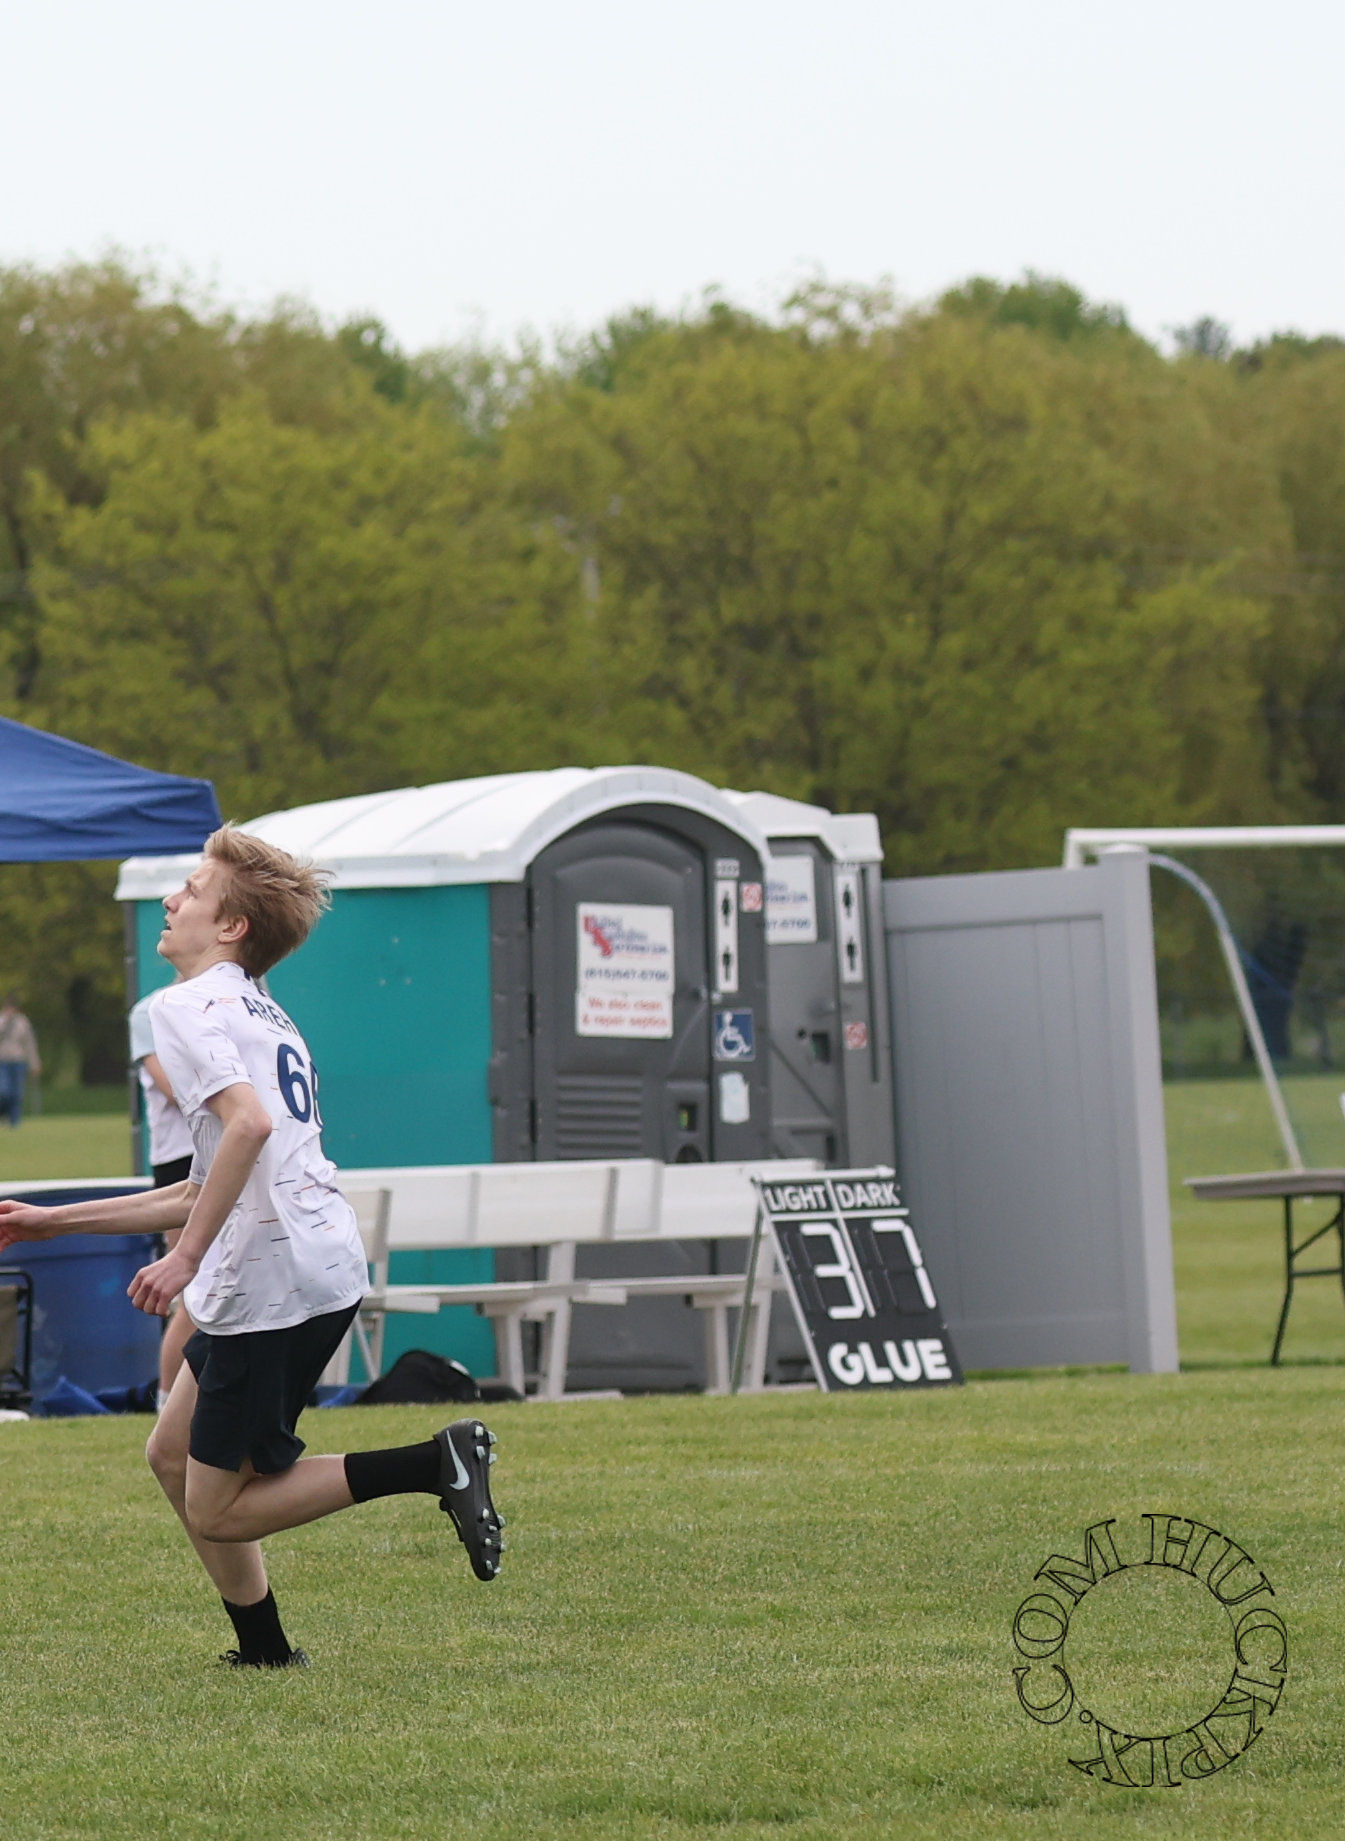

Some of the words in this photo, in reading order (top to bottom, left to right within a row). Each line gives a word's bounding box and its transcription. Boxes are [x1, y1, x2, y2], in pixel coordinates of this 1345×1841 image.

[762, 1185, 828, 1211] LIGHT
[834, 1182, 901, 1208] DARK
[799, 1222, 866, 1320] 3
[871, 1218, 937, 1310] 7
[826, 1338, 953, 1386] GLUE
